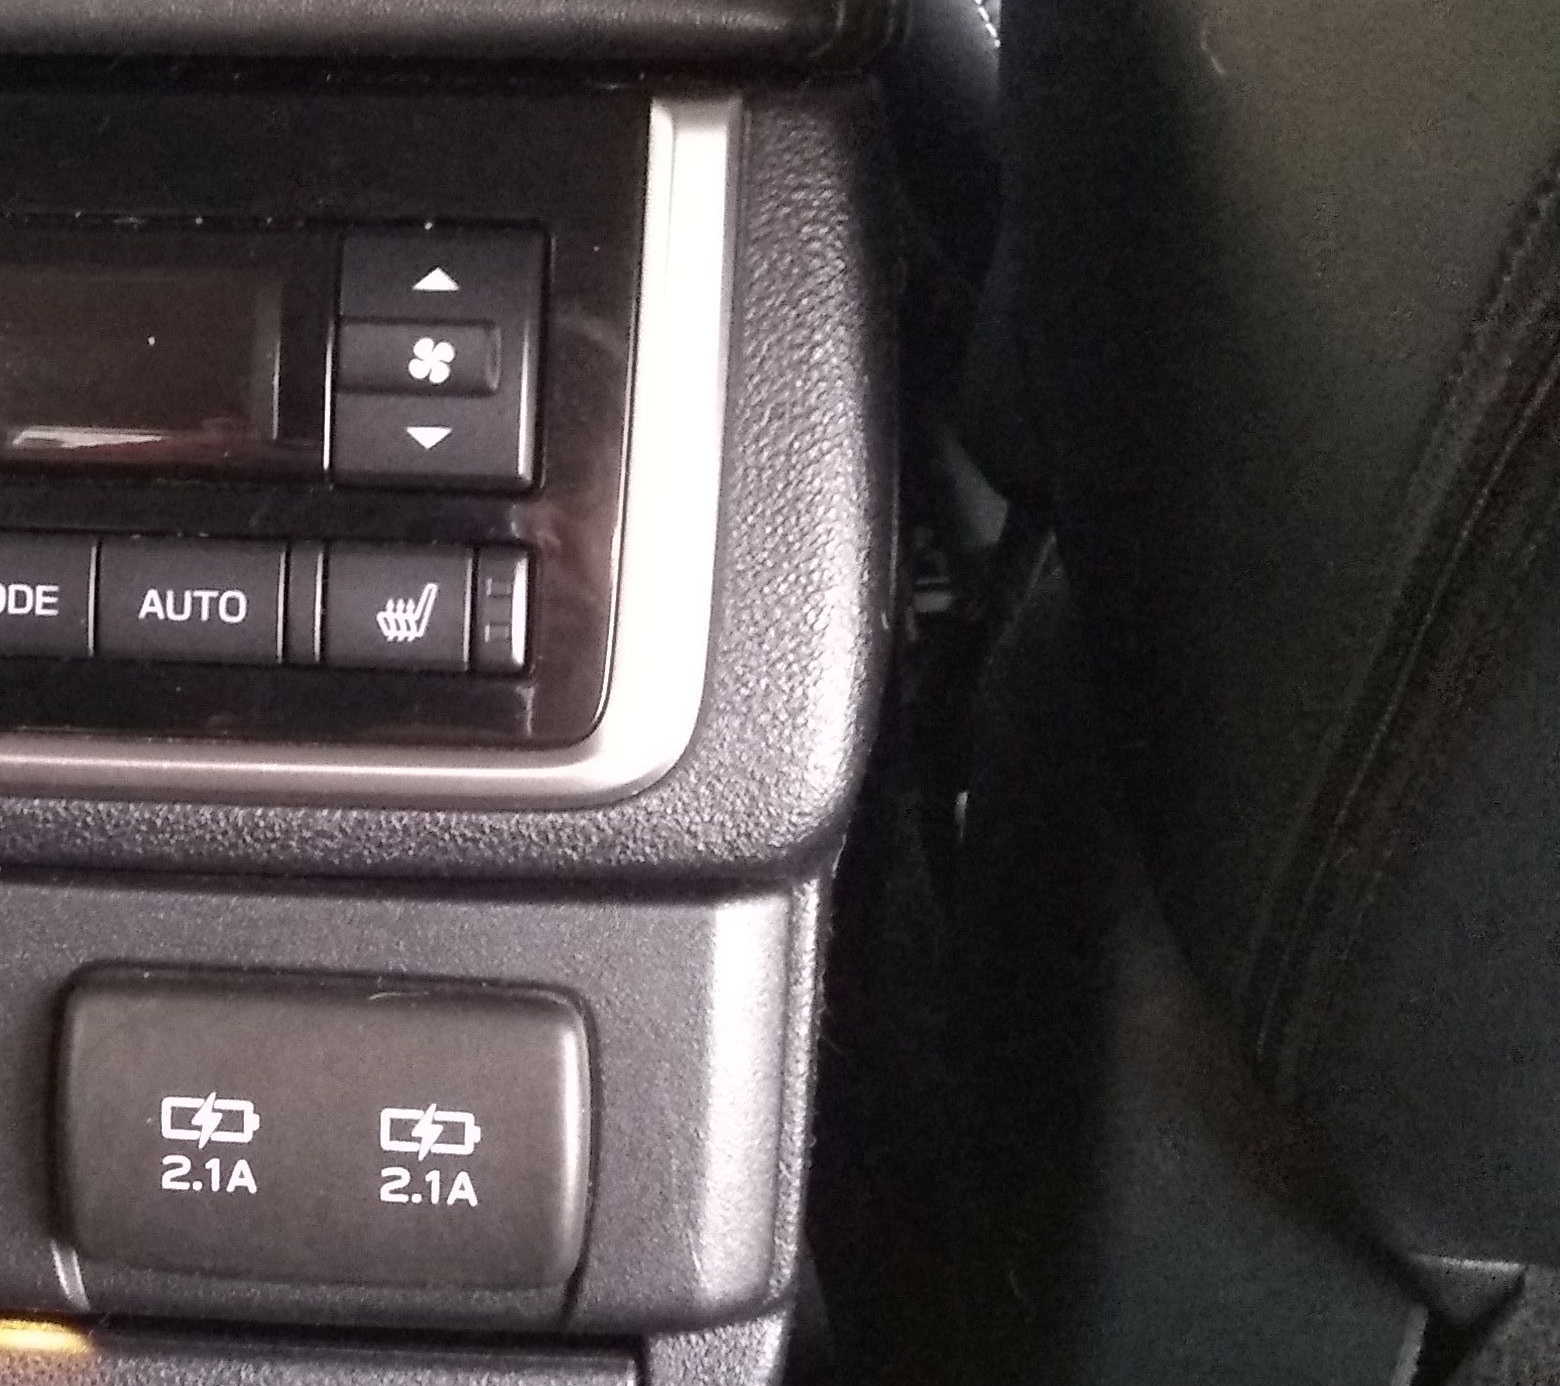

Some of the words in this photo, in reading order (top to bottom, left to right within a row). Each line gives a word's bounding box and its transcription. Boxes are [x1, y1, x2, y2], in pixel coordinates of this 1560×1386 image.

[138, 588, 247, 624] AUTO
[160, 1154, 258, 1194] 2.1A
[379, 1166, 479, 1207] 2.1A
